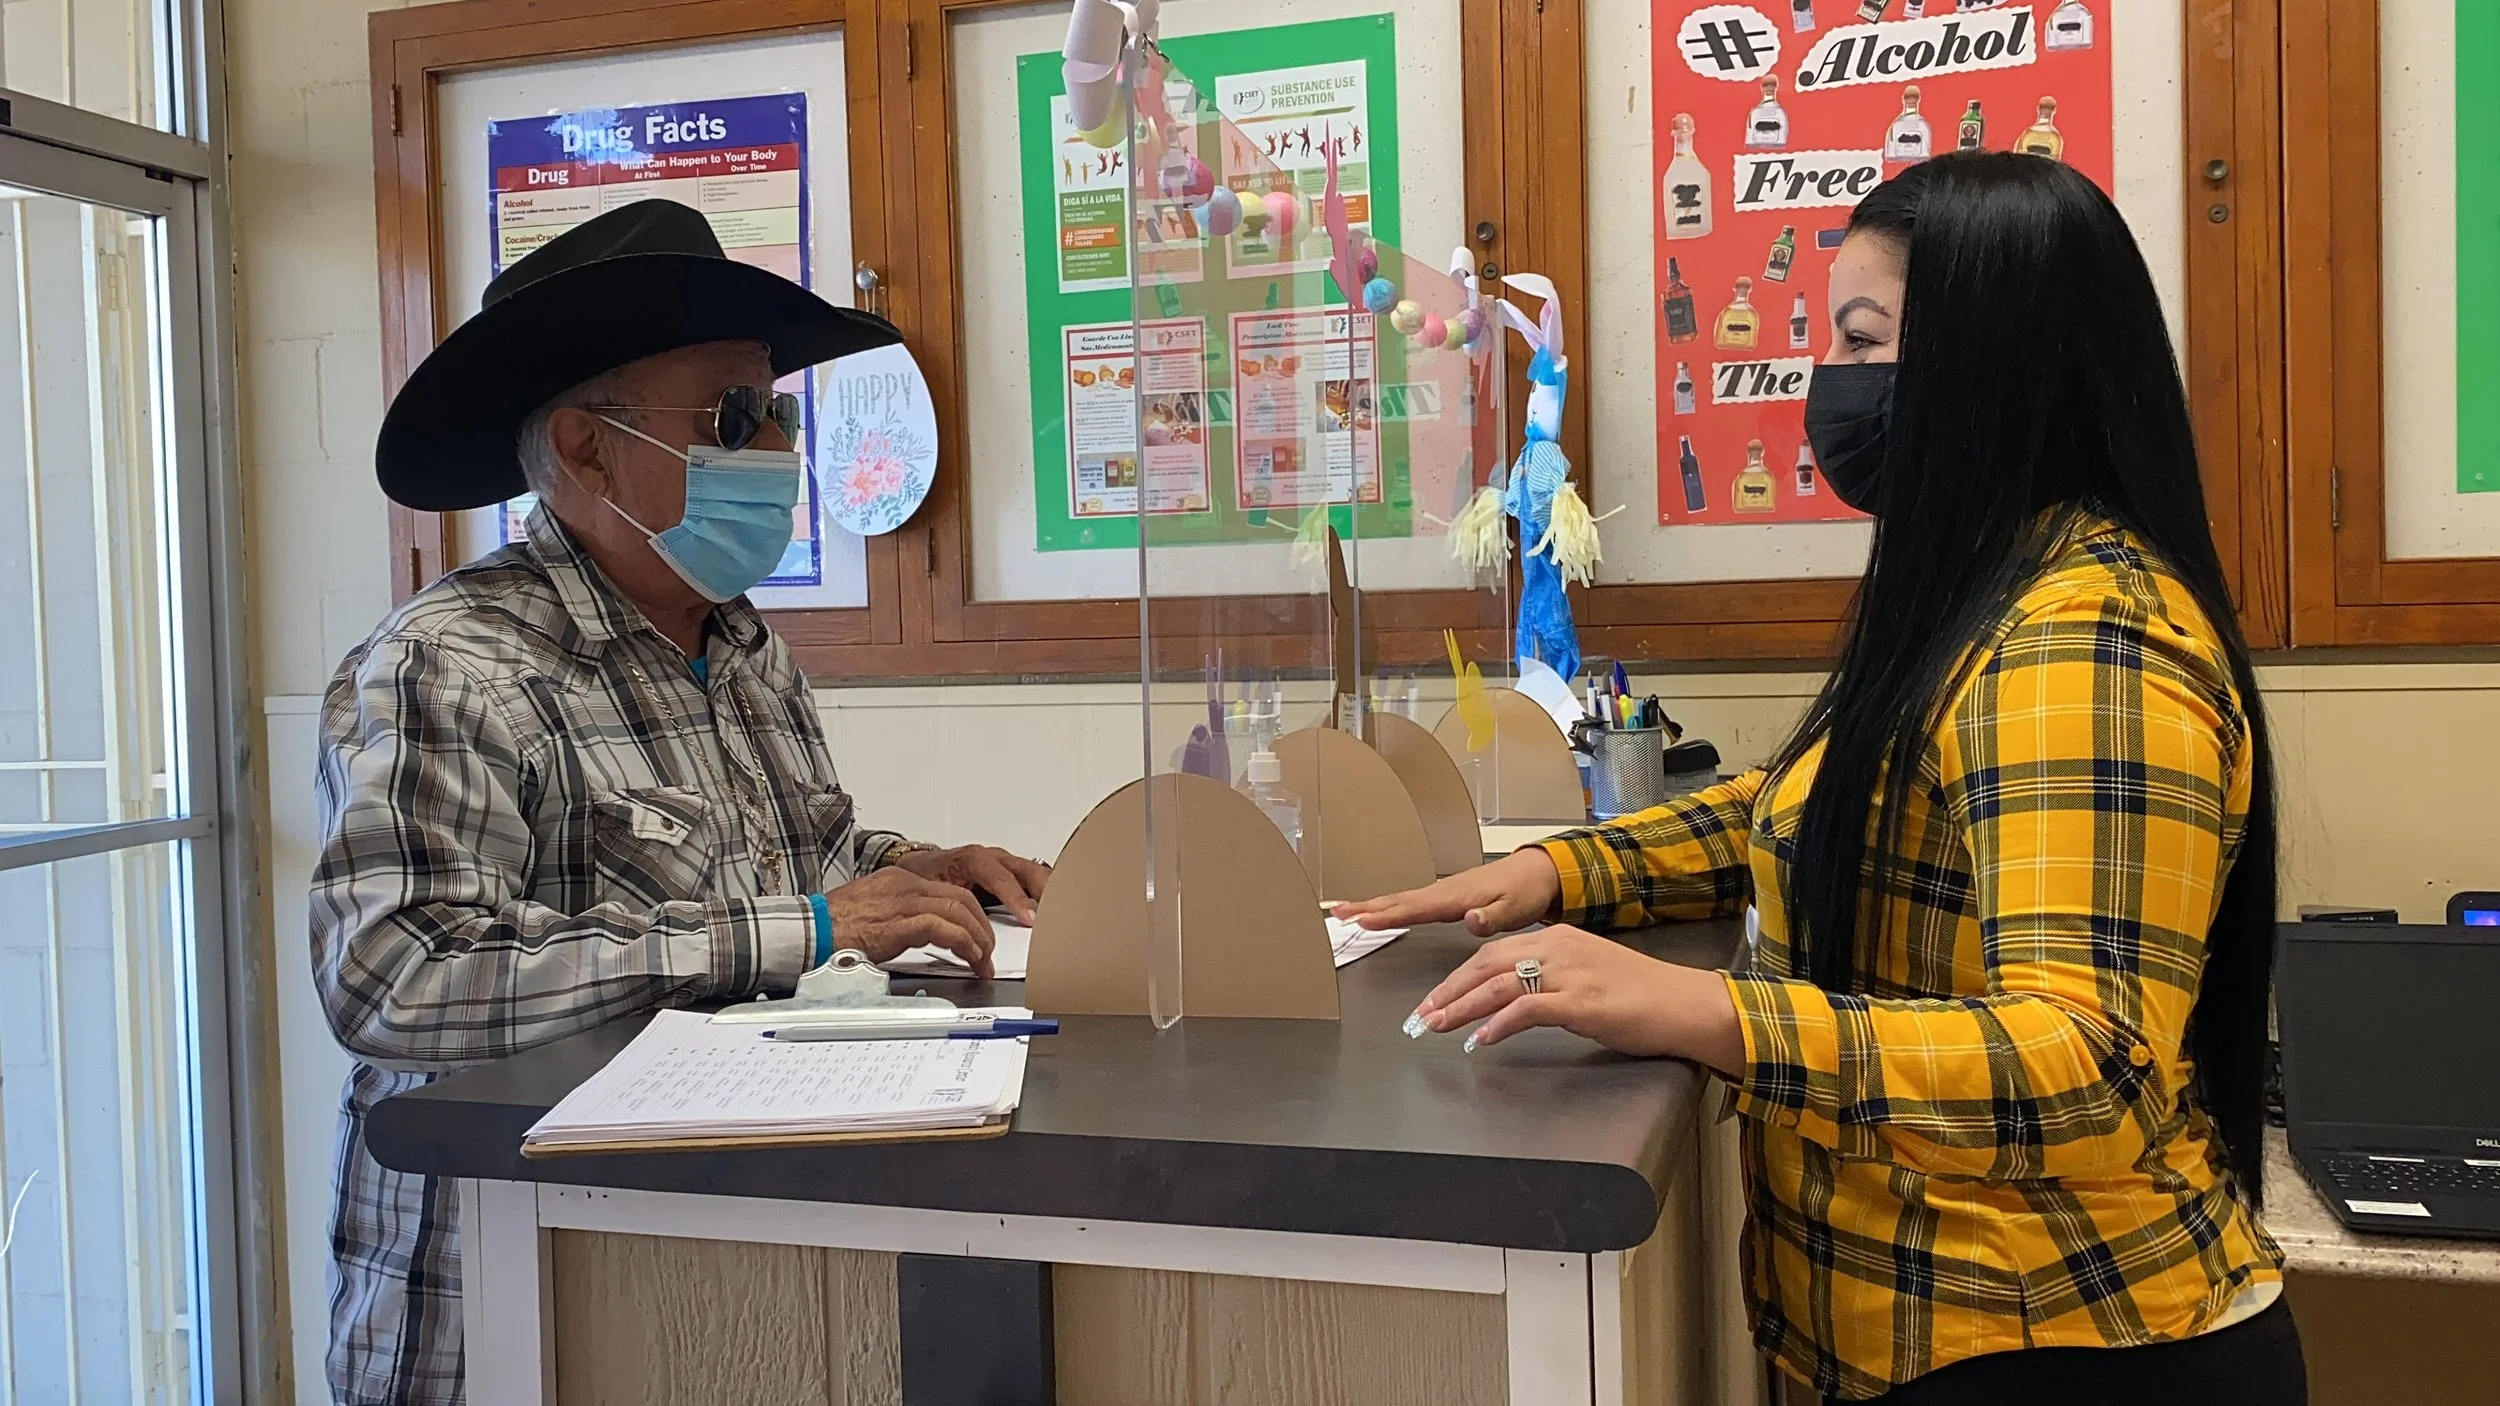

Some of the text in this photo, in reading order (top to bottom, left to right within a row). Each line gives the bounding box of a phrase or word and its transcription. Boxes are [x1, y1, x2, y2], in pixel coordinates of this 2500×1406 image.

[1797, 10, 2032, 87] Alcohol
[1271, 75, 1356, 96] SUBSTANCE USE
[1244, 90, 1259, 99] CSET
[1271, 91, 1335, 109] PREVENTION
[562, 113, 727, 153] Drug Facts
[619, 149, 778, 172] What Can Happen to Your Body
[731, 163, 767, 173] Over Time
[527, 168, 569, 185] Drug
[634, 170, 661, 180] At First
[1735, 158, 1878, 206] Free
[503, 199, 533, 208] Alcohol
[1063, 197, 1081, 207] DIGA
[1089, 195, 1095, 204] A
[1095, 195, 1104, 204] LA
[1174, 329, 1197, 338] CSET
[1717, 362, 1804, 398] The
[838, 371, 913, 418] HAPPY
[2476, 1138, 2500, 1147] DELL
